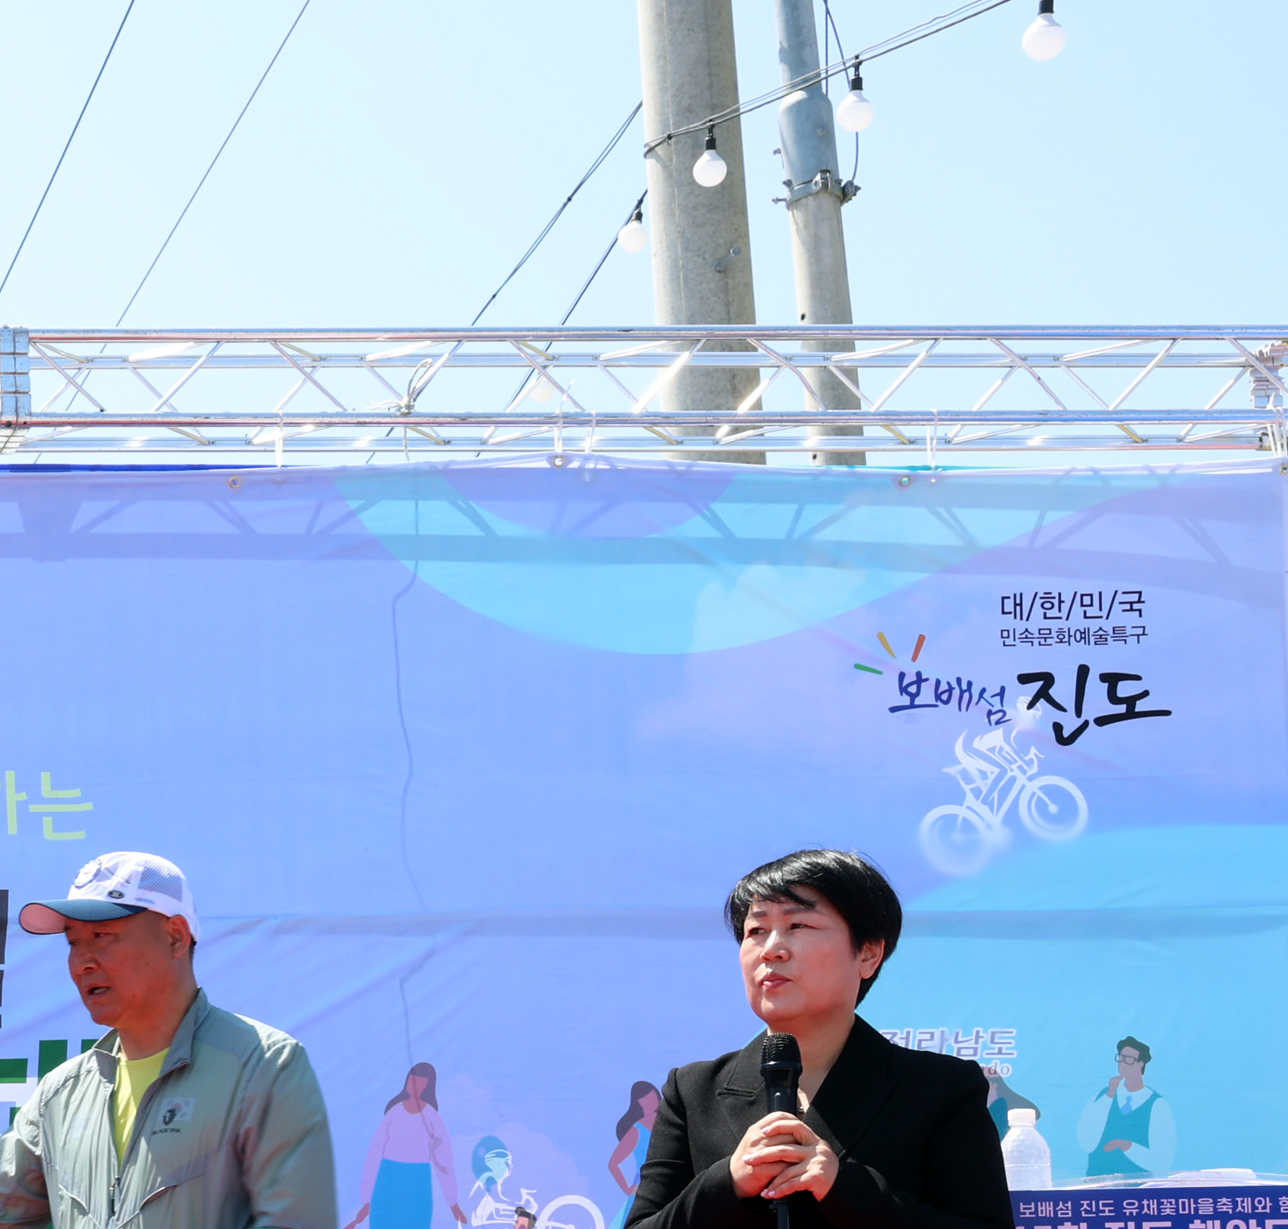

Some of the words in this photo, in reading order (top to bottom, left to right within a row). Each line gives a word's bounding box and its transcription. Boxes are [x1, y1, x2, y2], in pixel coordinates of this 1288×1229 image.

[1000, 626, 1148, 646] 민속문화예술특구
[888, 671, 1012, 726] 보배섬
[1017, 664, 1172, 746] 진도
[1019, 1201, 1072, 1217] 보배섬
[1080, 1200, 1115, 1216] 진도
[1123, 1197, 1272, 1216] 유채꽃마을축제와
